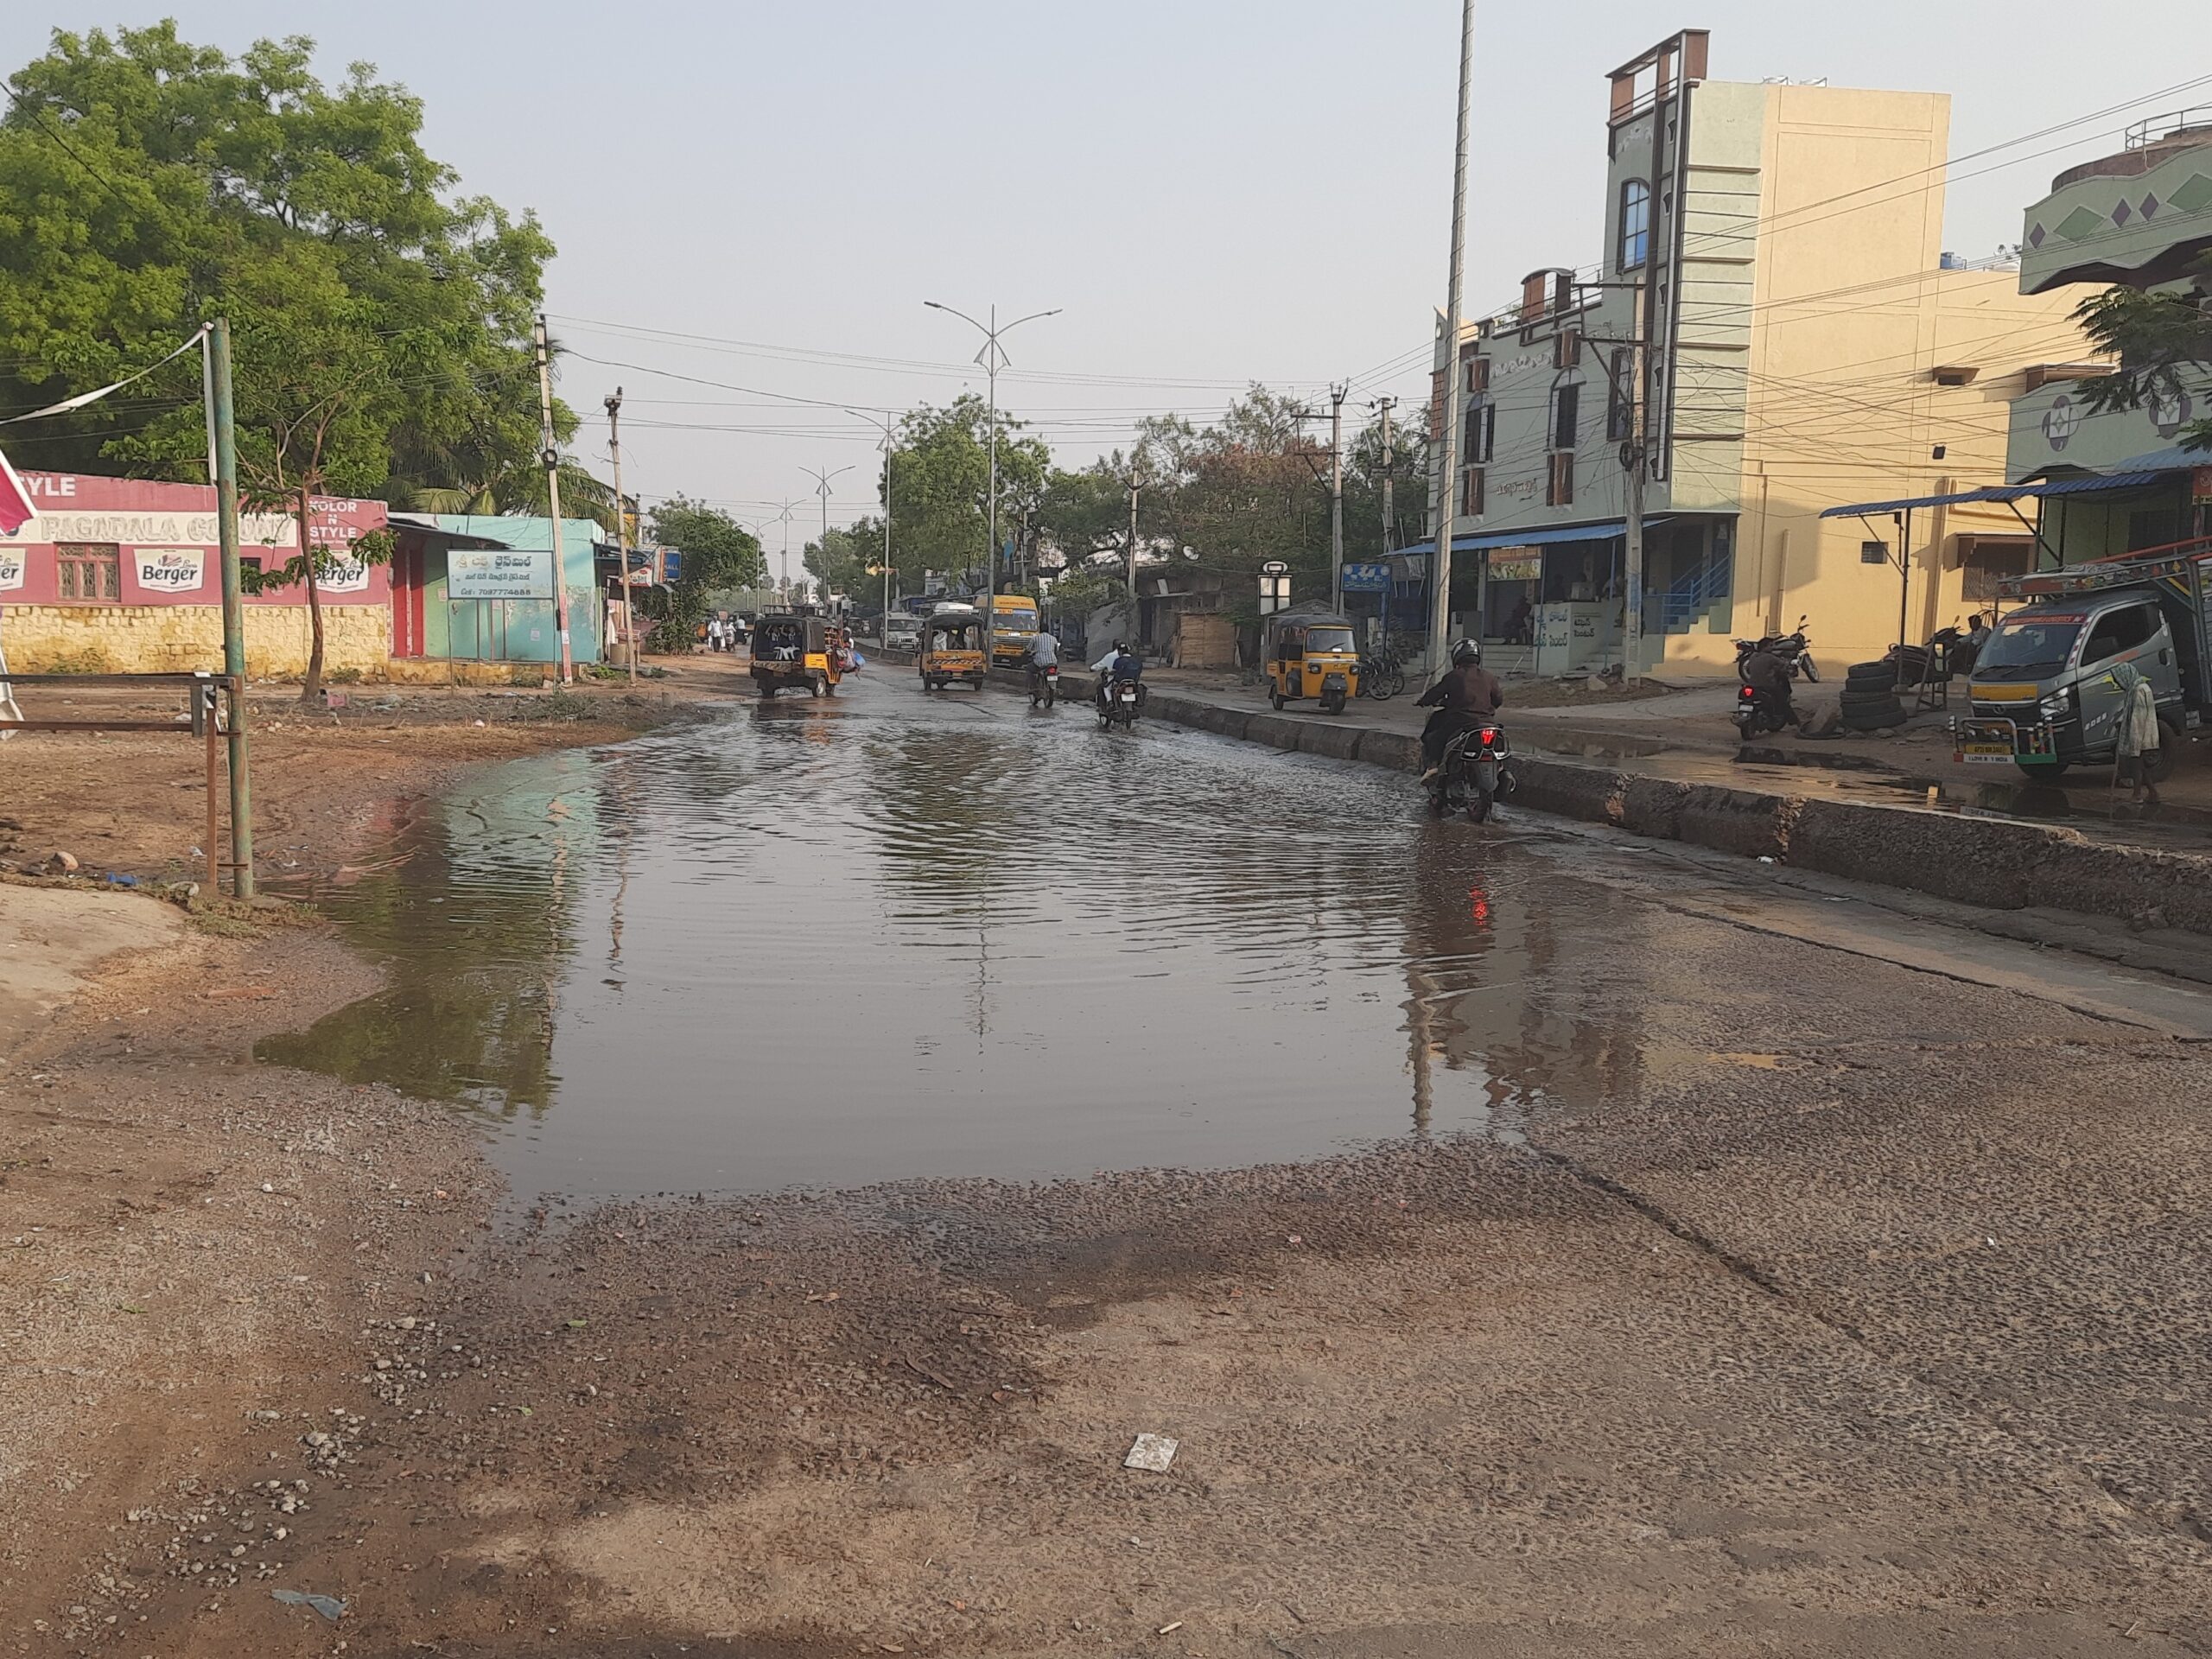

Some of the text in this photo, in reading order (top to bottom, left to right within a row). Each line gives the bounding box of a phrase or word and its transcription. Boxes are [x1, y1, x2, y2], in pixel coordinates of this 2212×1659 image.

[308, 500, 358, 512] KOLOR
[327, 513, 338, 524] N
[41, 516, 180, 542] PAGADALA
[188, 516, 292, 543] COONY
[309, 526, 357, 538] STYLE
[143, 565, 198, 584] Berger
